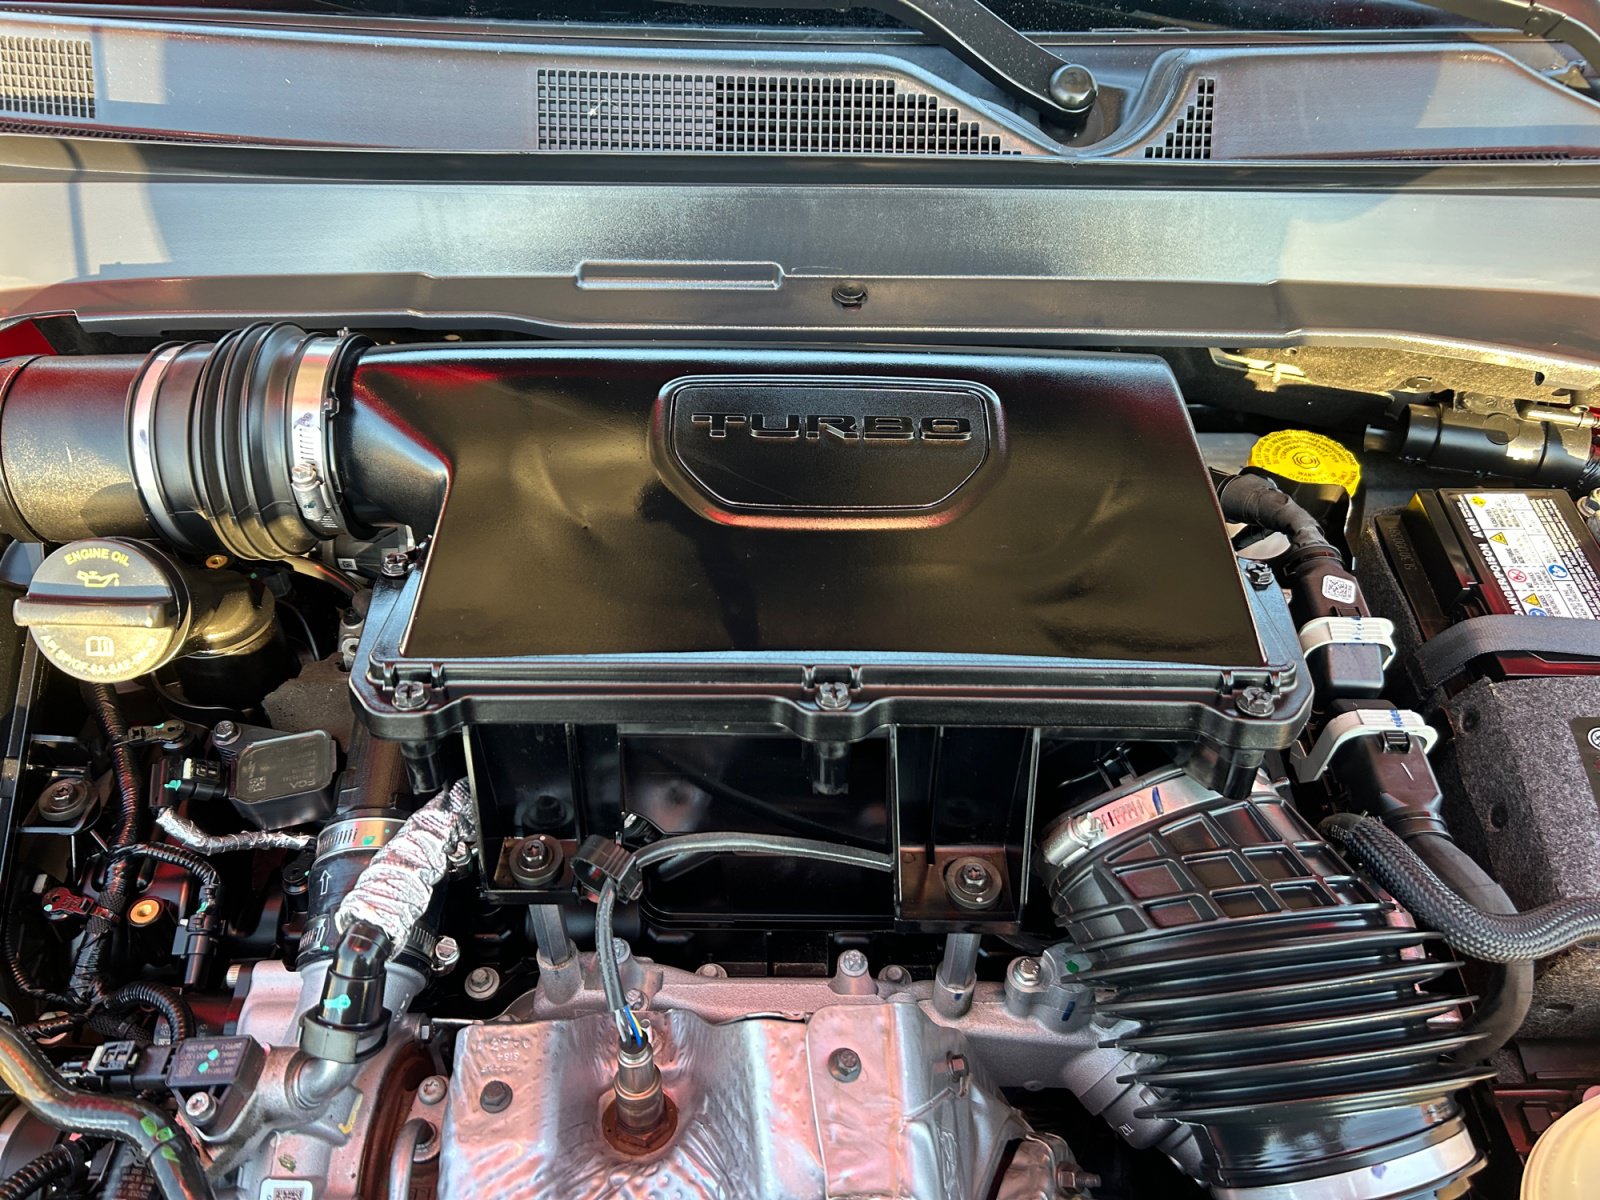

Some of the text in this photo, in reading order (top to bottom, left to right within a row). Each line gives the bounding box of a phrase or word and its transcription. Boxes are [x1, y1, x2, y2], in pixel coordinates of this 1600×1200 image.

[691, 412, 972, 441] TURBO
[63, 548, 130, 567] ENGINE OIL
[40, 635, 58, 652] API
